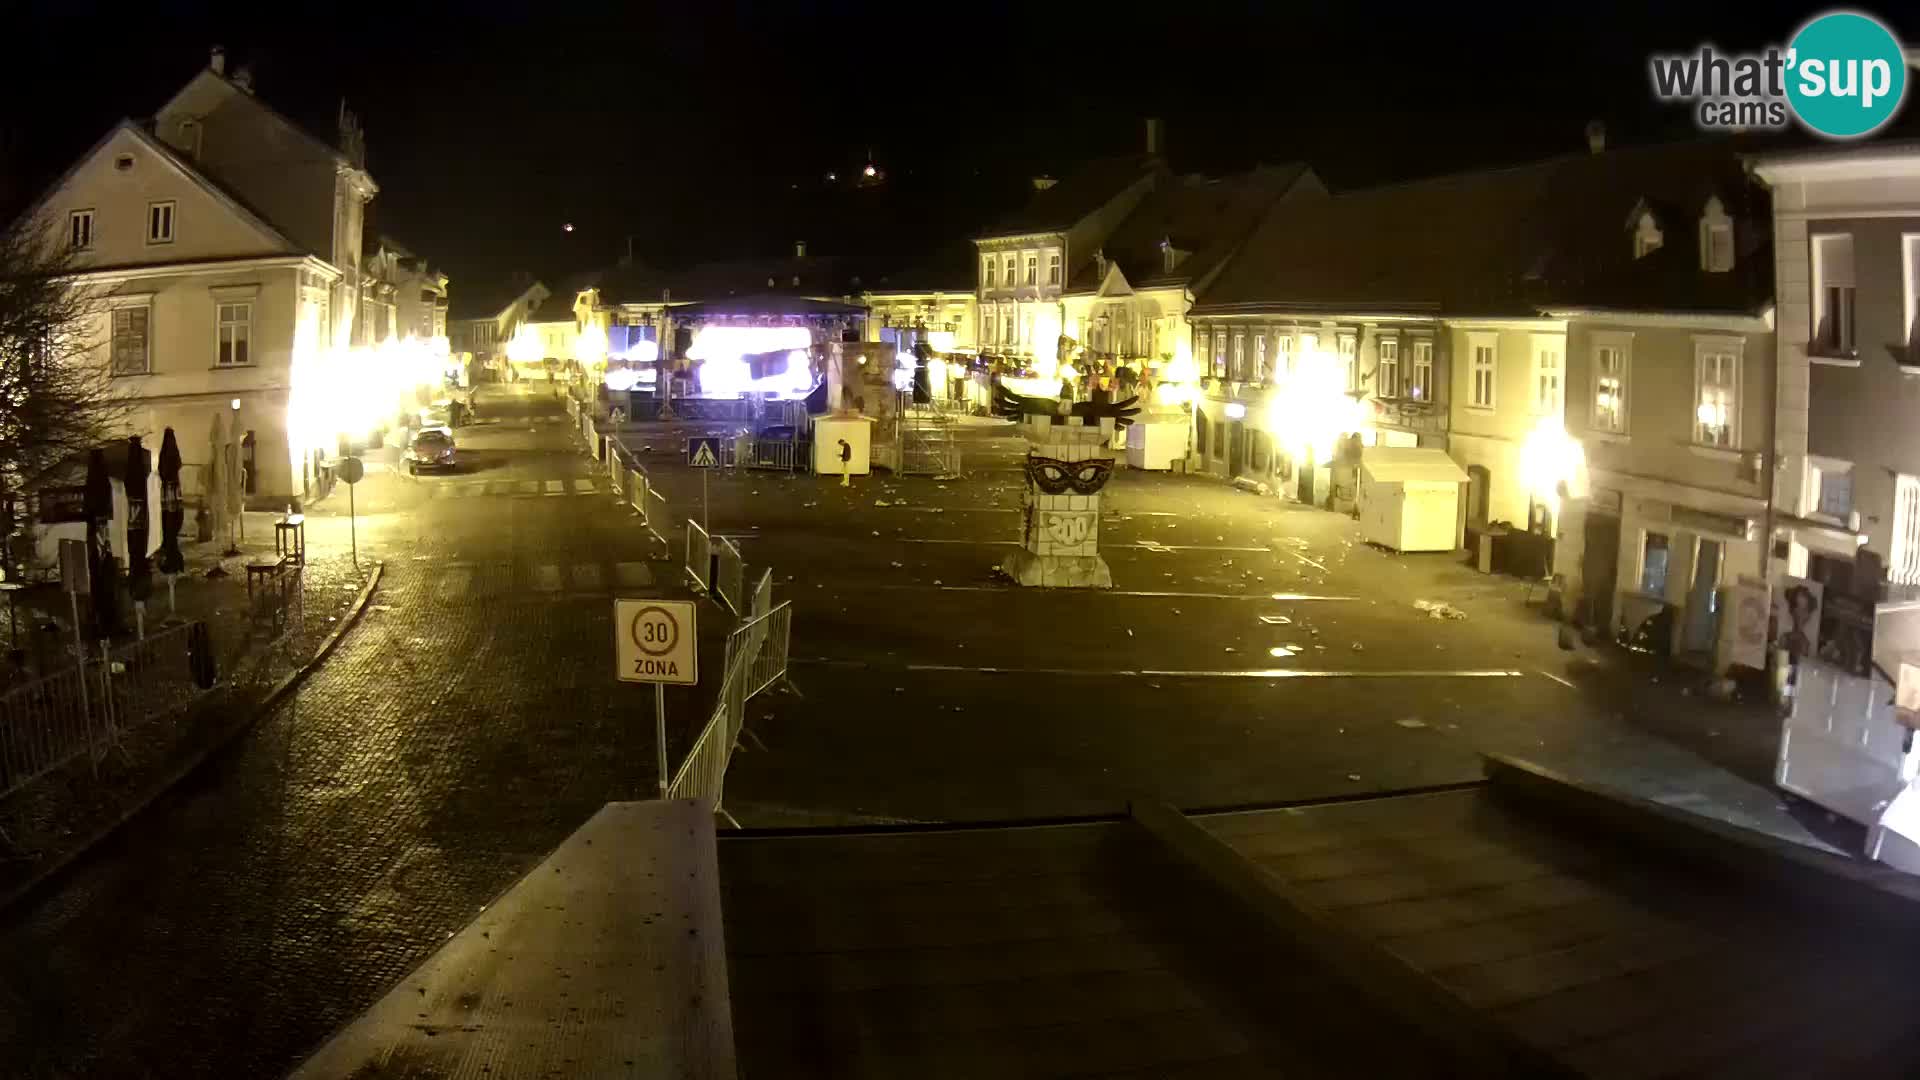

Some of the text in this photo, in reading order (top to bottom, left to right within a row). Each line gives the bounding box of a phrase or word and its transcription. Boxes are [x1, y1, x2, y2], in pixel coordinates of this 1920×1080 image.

[1048, 516, 1087, 545] 200
[644, 622, 668, 643] 30
[634, 659, 679, 676] ZONA
